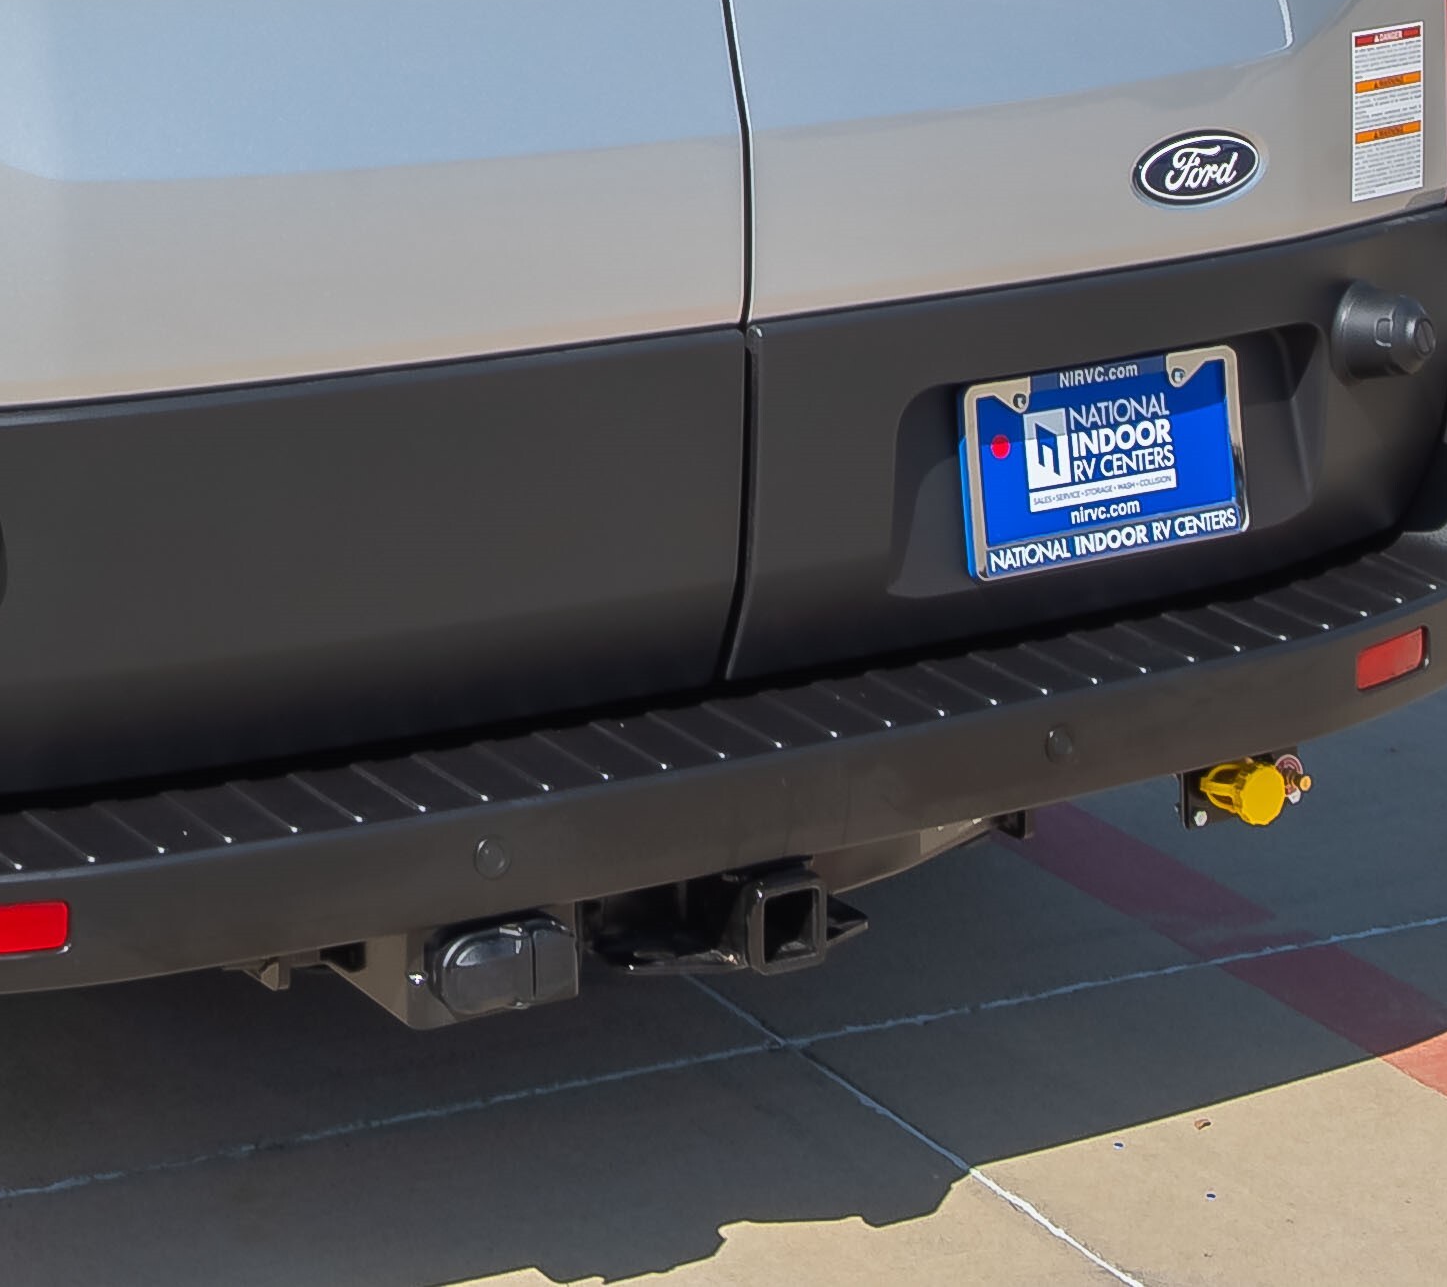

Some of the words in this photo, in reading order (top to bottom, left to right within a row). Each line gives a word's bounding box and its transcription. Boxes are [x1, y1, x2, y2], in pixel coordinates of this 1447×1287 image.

[1165, 145, 1238, 192] Ford
[1059, 362, 1138, 388] NIRVC.com
[1069, 392, 1170, 430] NATIONAL
[1071, 418, 1172, 457] INDOOR
[1073, 457, 1097, 482] RV
[1100, 445, 1175, 478] CENTERS
[1070, 499, 1141, 525] nirvc.com
[990, 541, 1071, 573] NATIONAL
[1074, 524, 1149, 556] INDOOR
[1152, 519, 1173, 541] RV
[1174, 507, 1237, 534] CENTERS
